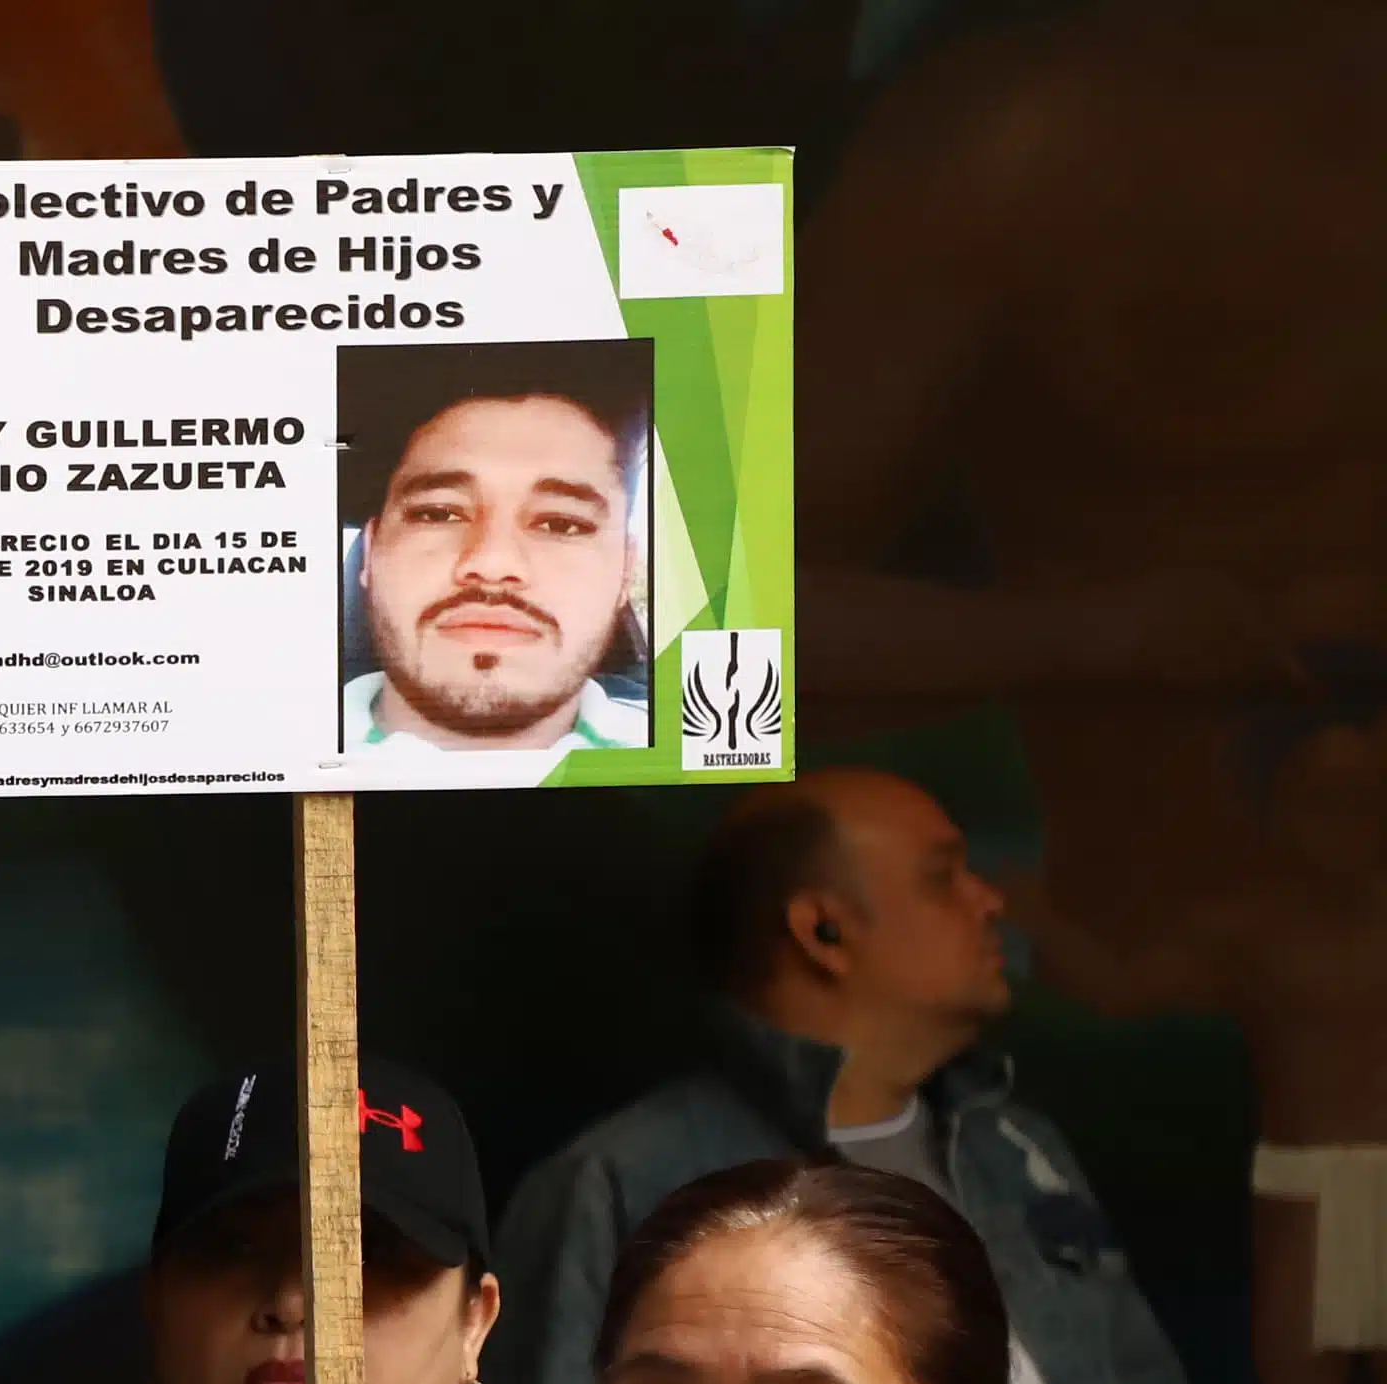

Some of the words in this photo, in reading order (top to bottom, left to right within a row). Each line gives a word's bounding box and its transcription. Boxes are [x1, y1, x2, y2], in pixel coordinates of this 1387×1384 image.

[226, 180, 294, 216] de
[315, 178, 512, 215] Padres
[532, 184, 563, 219] y
[20, 240, 227, 276] Madres
[248, 237, 316, 273] de
[338, 235, 481, 280] Hijos
[36, 294, 465, 340] Desaparecidos
[27, 417, 305, 448] GUILLERMO
[67, 461, 286, 491] ZAZUETA
[106, 533, 140, 551] EL
[153, 532, 201, 550] DIA
[215, 531, 247, 549] 15
[261, 531, 298, 548] DE
[26, 558, 93, 577] 2019
[107, 558, 145, 575] EN
[157, 556, 307, 575] CULIACAN
[28, 584, 155, 603] SINALOA
[51, 702, 77, 716] INF
[82, 701, 148, 715] LLAMAR
[152, 700, 173, 714] AL
[61, 724, 70, 736] y
[74, 720, 169, 734] 6672937607
[703, 753, 771, 767] RASTREADORAS
